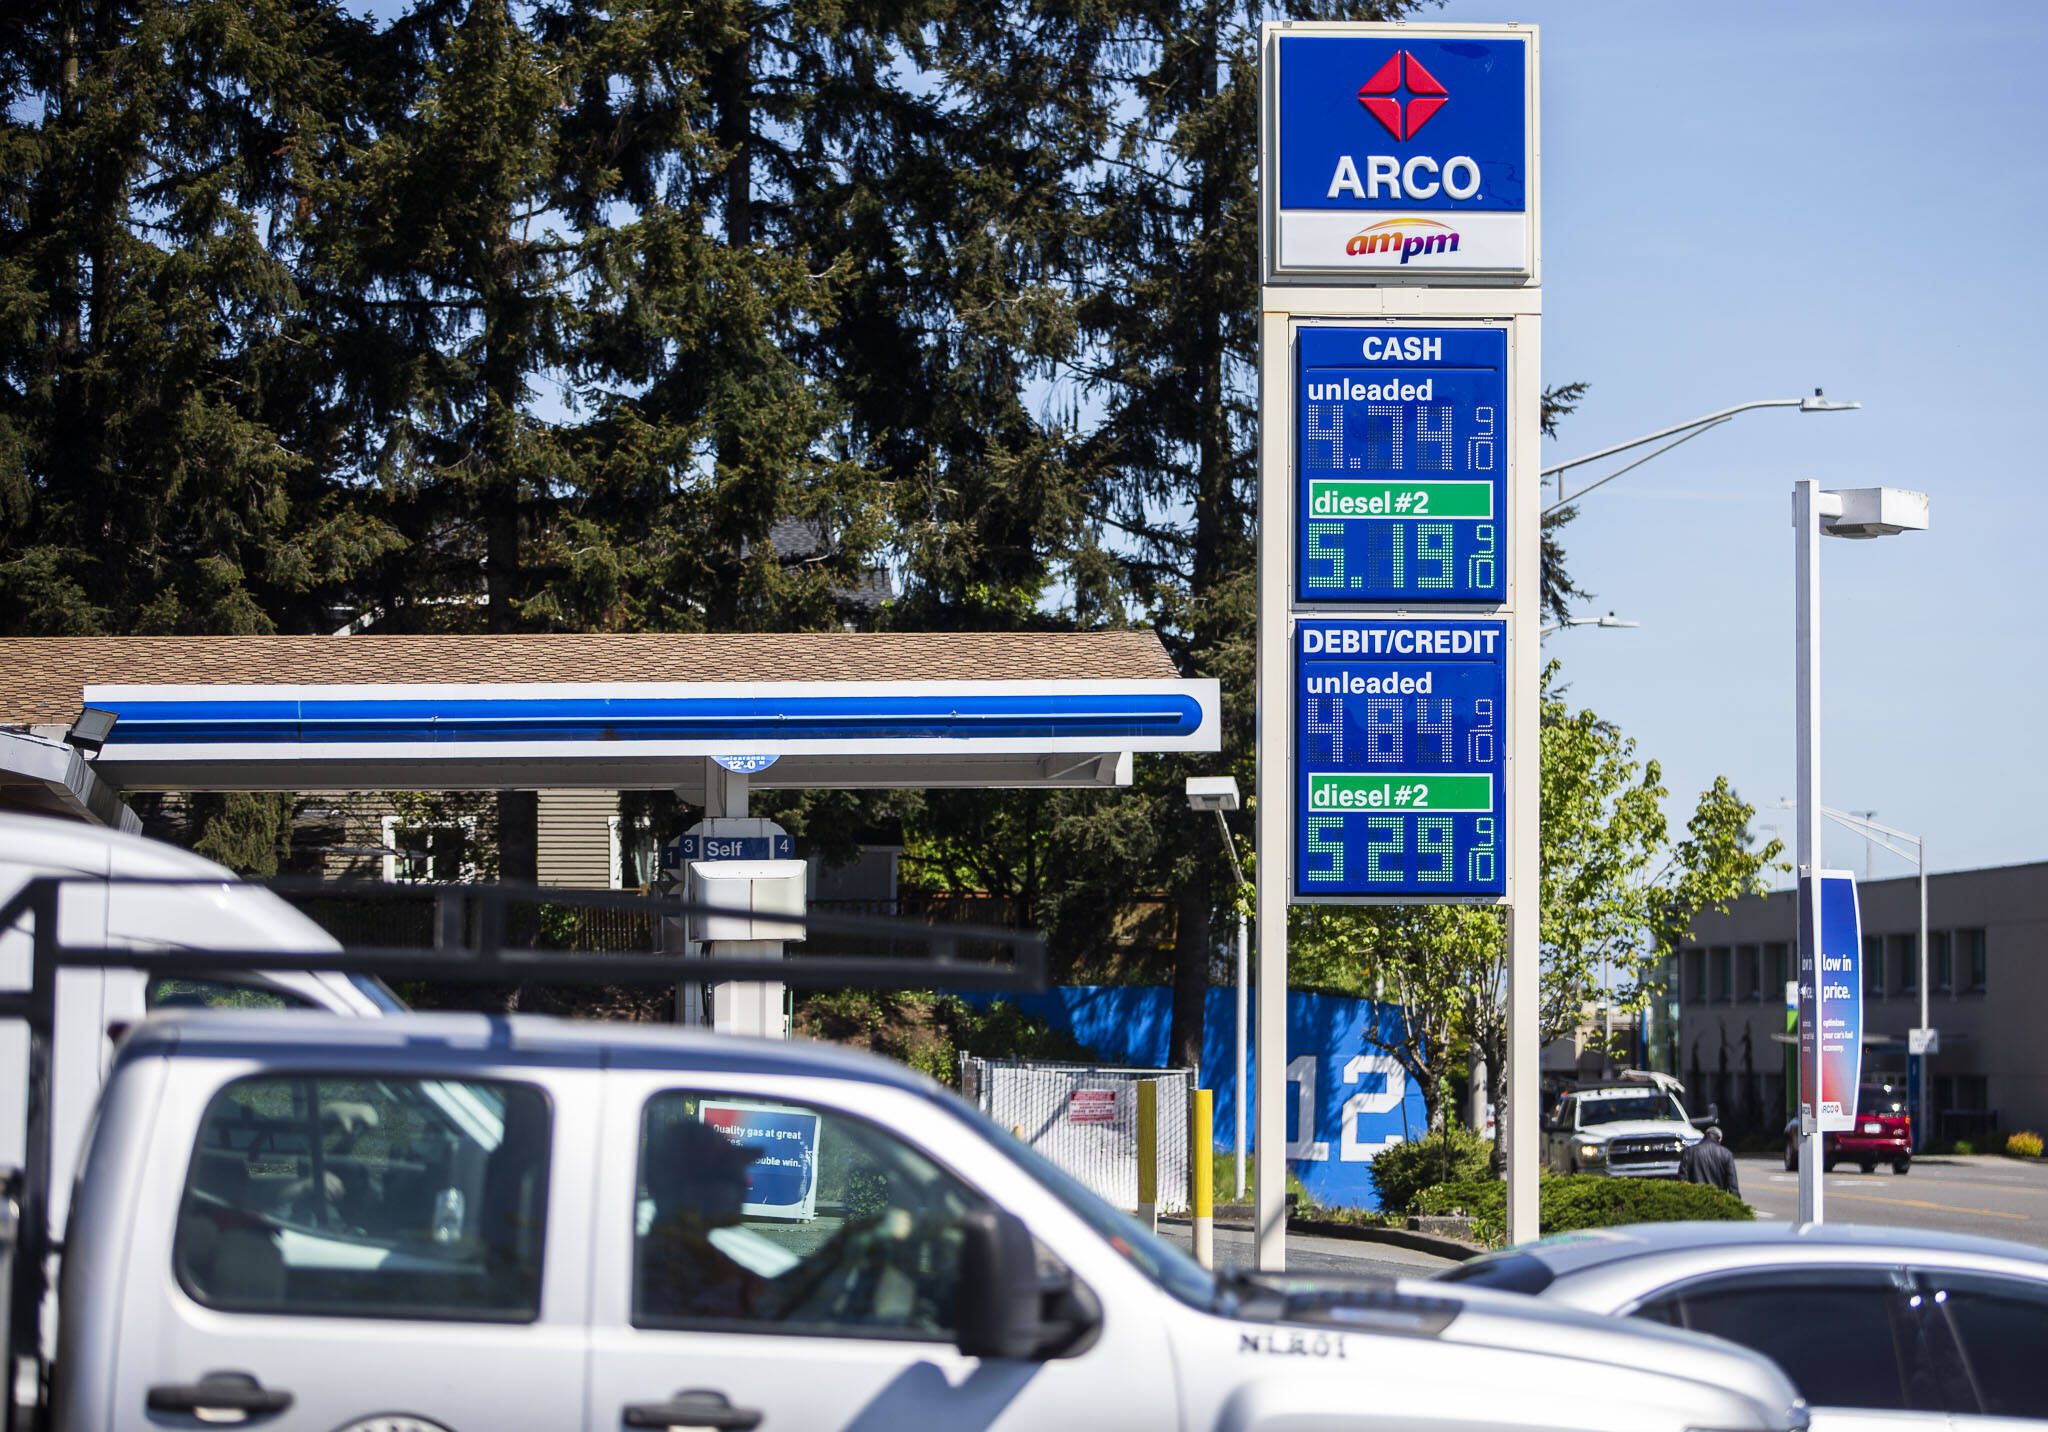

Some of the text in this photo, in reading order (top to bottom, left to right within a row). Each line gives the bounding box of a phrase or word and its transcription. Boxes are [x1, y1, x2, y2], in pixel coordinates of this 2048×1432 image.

[1327, 156, 1480, 200] ARCO
[1345, 232, 1460, 264] ampm
[1362, 336, 1442, 361] CASH
[1308, 378, 1433, 401] unleaded
[1308, 404, 1453, 470] 4.74
[1314, 491, 1429, 514] diesel #2
[1308, 523, 1454, 588] 5.19
[1303, 630, 1500, 654] DEBIT/CREDIT
[1307, 671, 1432, 694] unleaded
[1313, 783, 1429, 807] diesel #2
[684, 839, 693, 853] 3
[706, 841, 743, 857] Self
[780, 839, 789, 853] 4
[1823, 954, 1852, 971] low in
[1823, 981, 1851, 1002] price.
[713, 1124, 802, 1141] Quality gas at great
[753, 1157, 801, 1168] ouble win.
